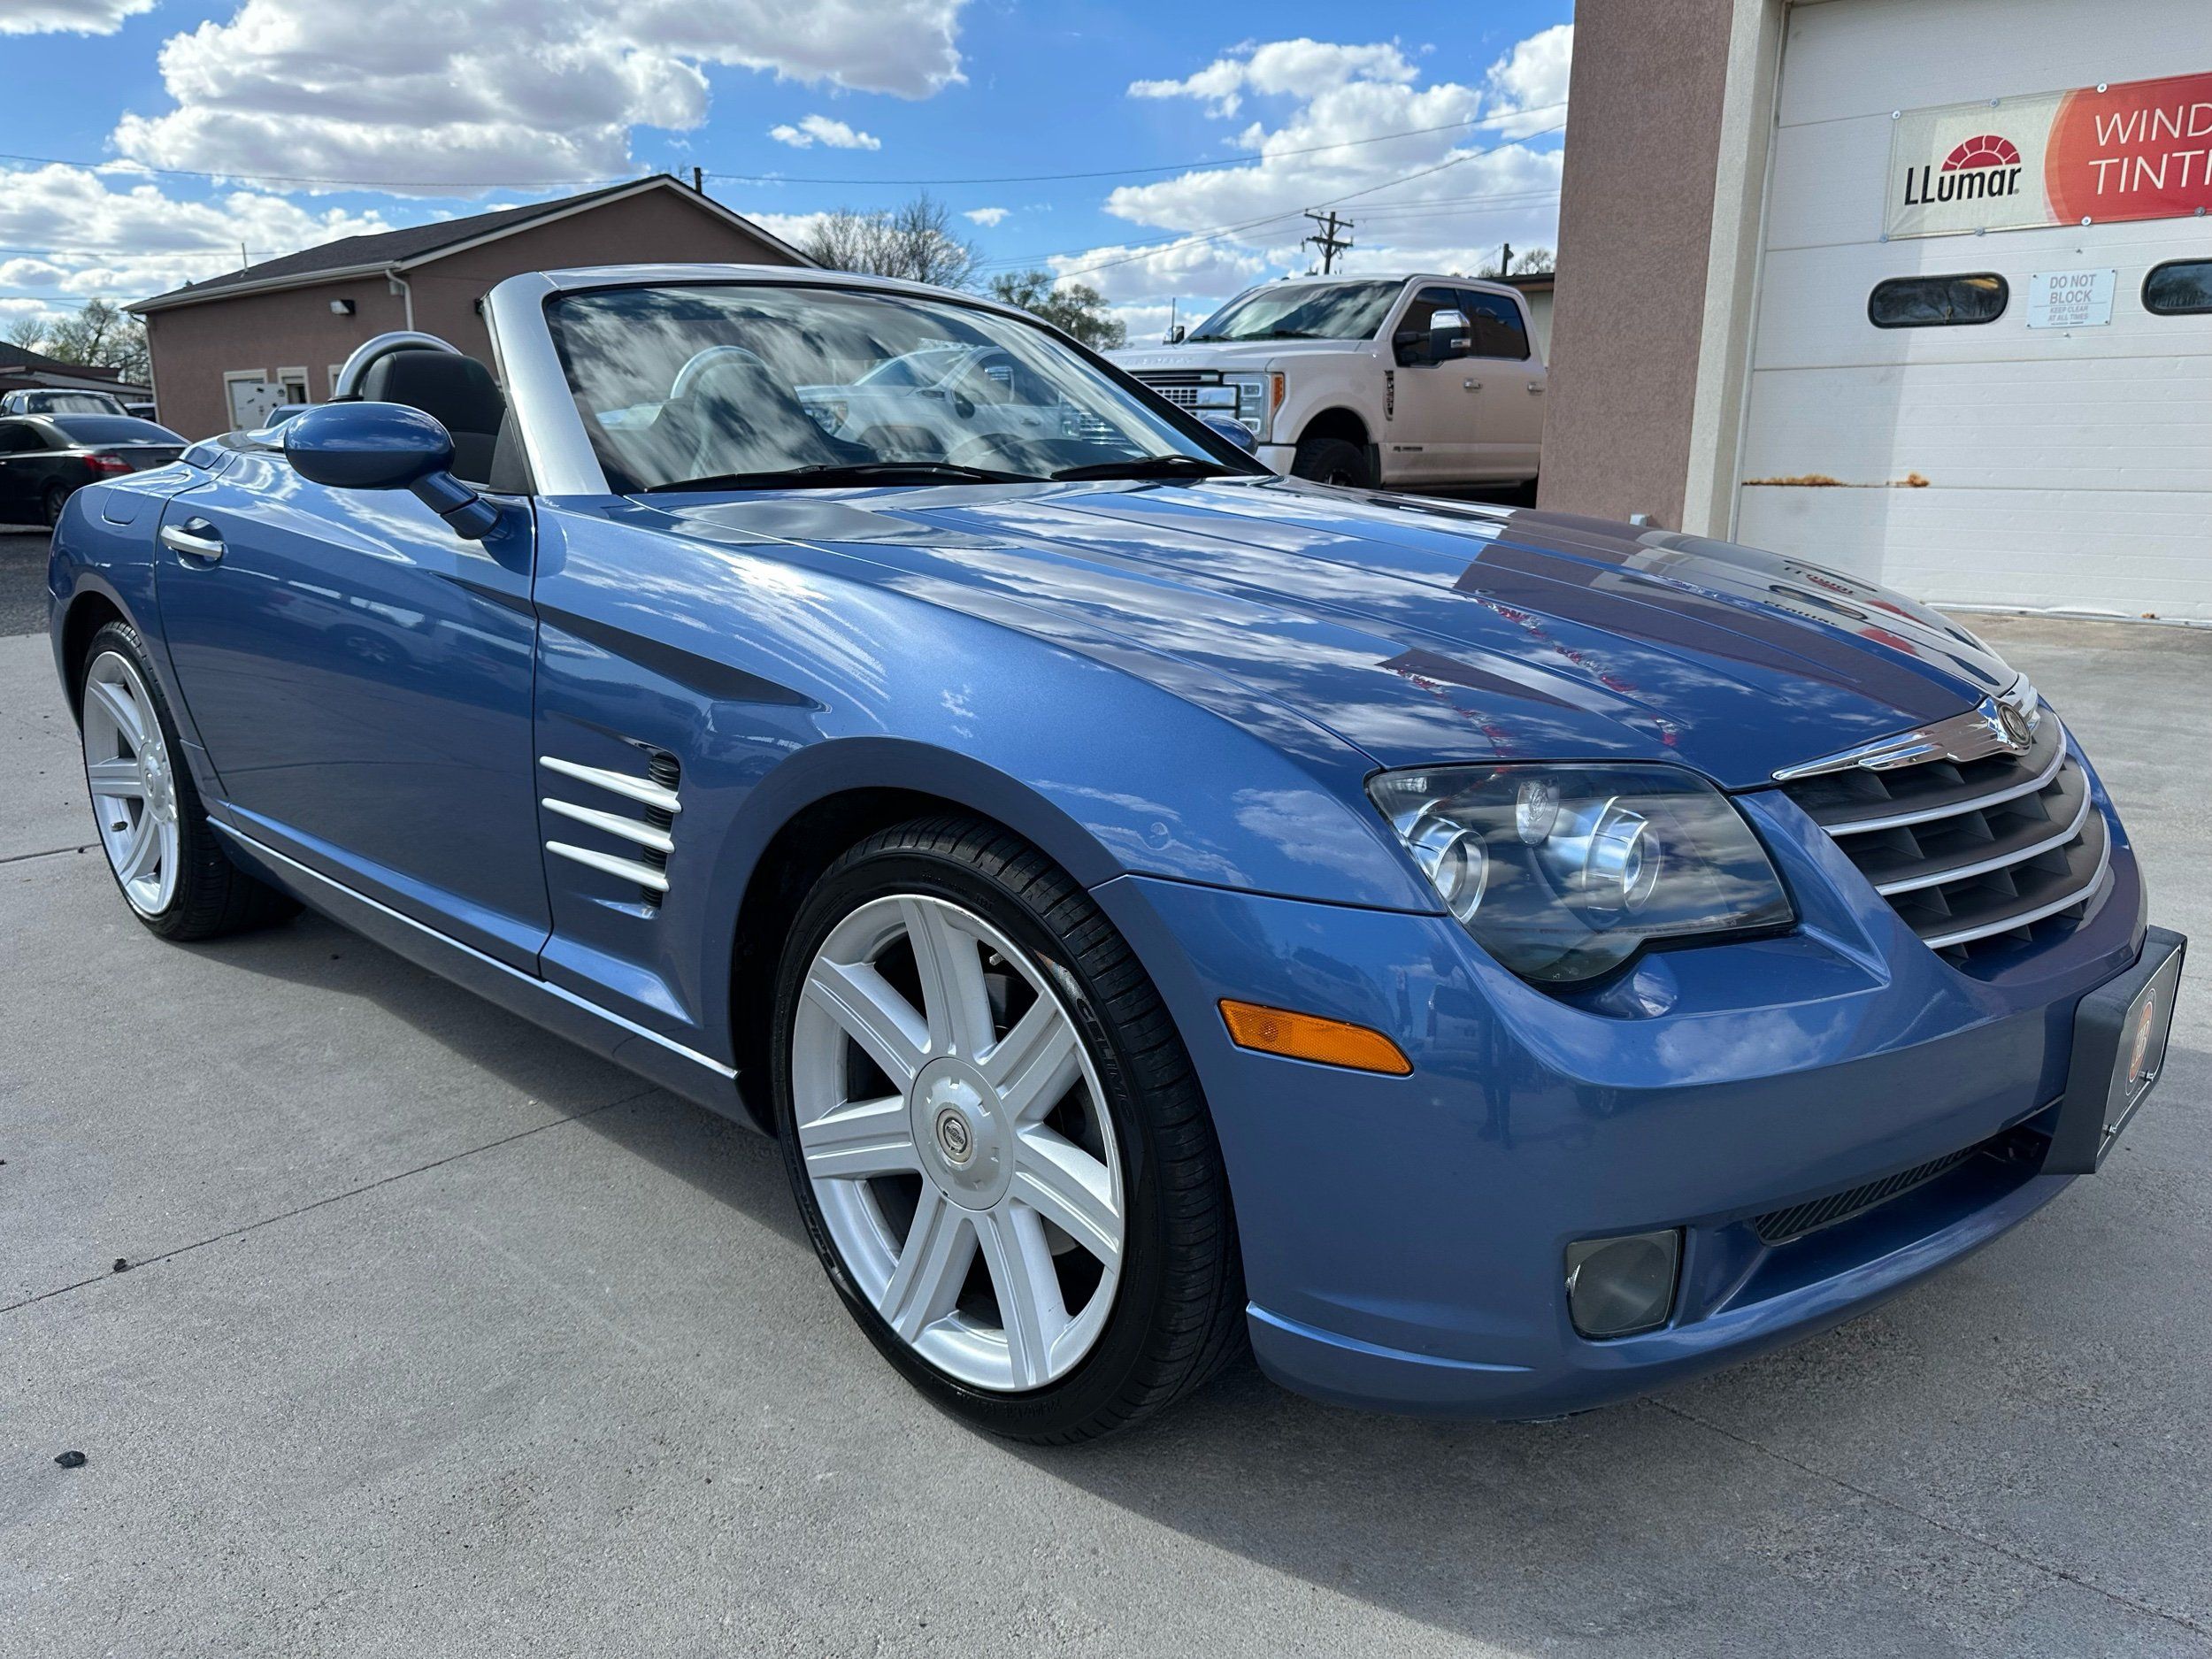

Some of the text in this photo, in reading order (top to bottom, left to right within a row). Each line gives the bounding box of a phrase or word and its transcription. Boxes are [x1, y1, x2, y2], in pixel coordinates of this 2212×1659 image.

[2095, 103, 2212, 146] WIND
[1904, 165, 2022, 205] LLumar
[2050, 274, 2096, 288] DO NOT
[2050, 289, 2092, 304] BLOCK
